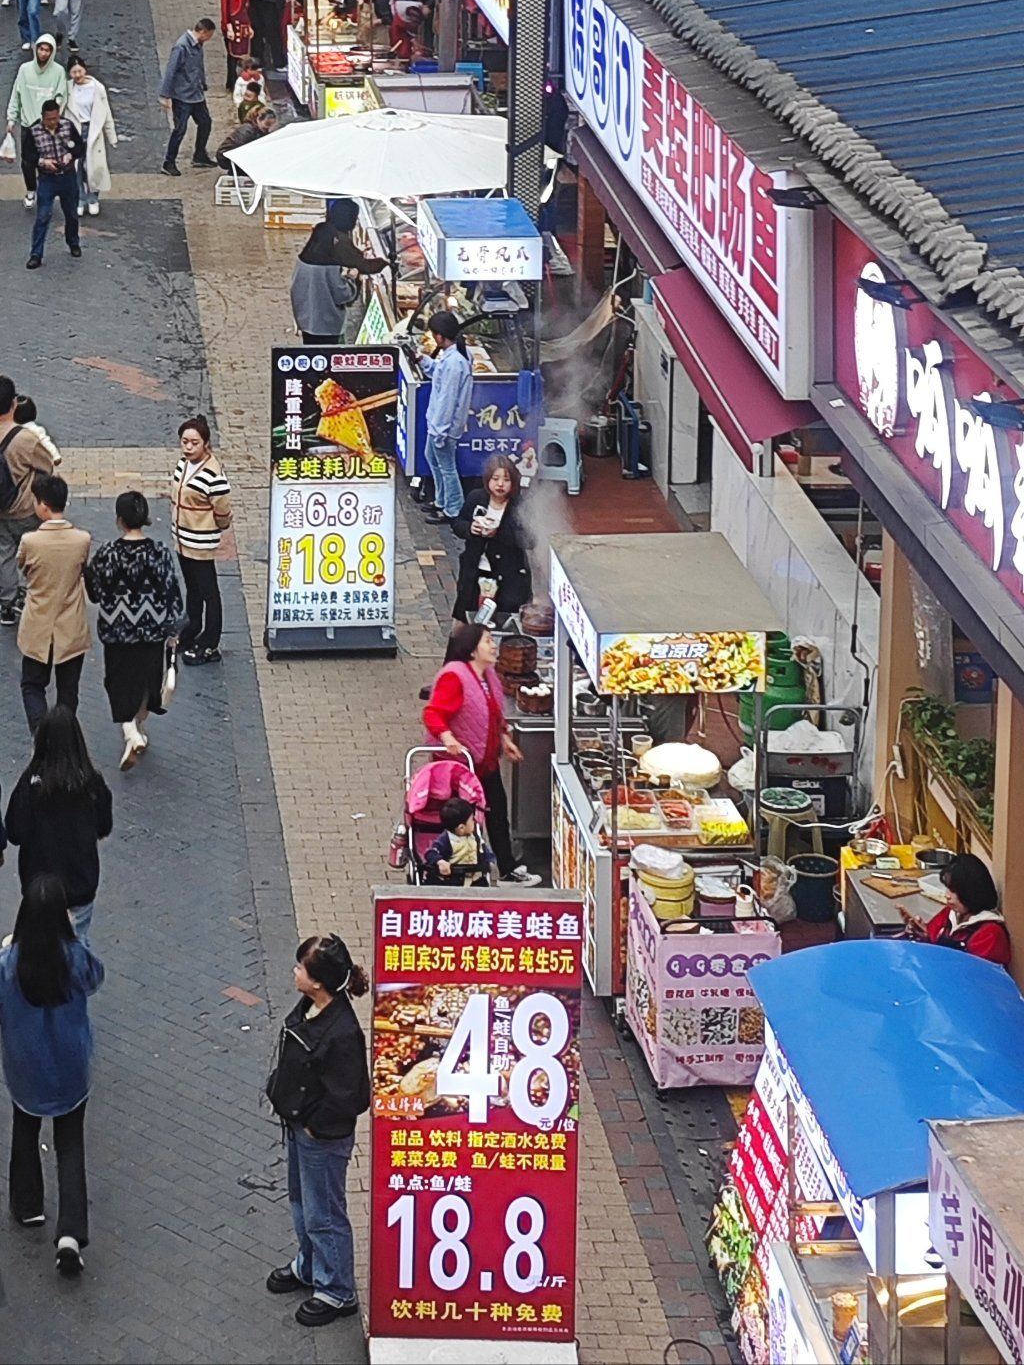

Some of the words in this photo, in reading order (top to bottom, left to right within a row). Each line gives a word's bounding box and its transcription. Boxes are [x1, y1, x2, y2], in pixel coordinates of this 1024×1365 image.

[284, 378, 303, 450] 隆重推出
[278, 456, 390, 480] 美蛙耗儿鱼
[283, 489, 304, 528] 鱼蛙
[305, 491, 360, 527] 6.8
[363, 504, 383, 525] 折
[277, 537, 292, 589] 折后价
[296, 532, 385, 585] 18.8
[273, 591, 338, 605] 饮料几十种免费
[320, 608, 352, 621] 乐堡2元
[357, 607, 389, 620] 纯生3元
[380, 909, 582, 941] 自助椒麻美蛙鱼
[384, 945, 456, 973] 醇国宾3元
[460, 944, 515, 972] 乐堡3元
[518, 945, 575, 974] 纯生5元
[492, 995, 512, 1072] 鱼/蛙自助
[436, 992, 570, 1125] 48
[390, 1130, 424, 1147] 甜品
[429, 1130, 462, 1147] 饮料
[467, 1132, 567, 1151] 指定酒水免费
[390, 1150, 458, 1169] 素菜免费
[471, 1152, 567, 1172] 鱼/蛙不限量
[387, 1193, 547, 1294] 18.8
[390, 1299, 564, 1324] 饮料几十种免费
